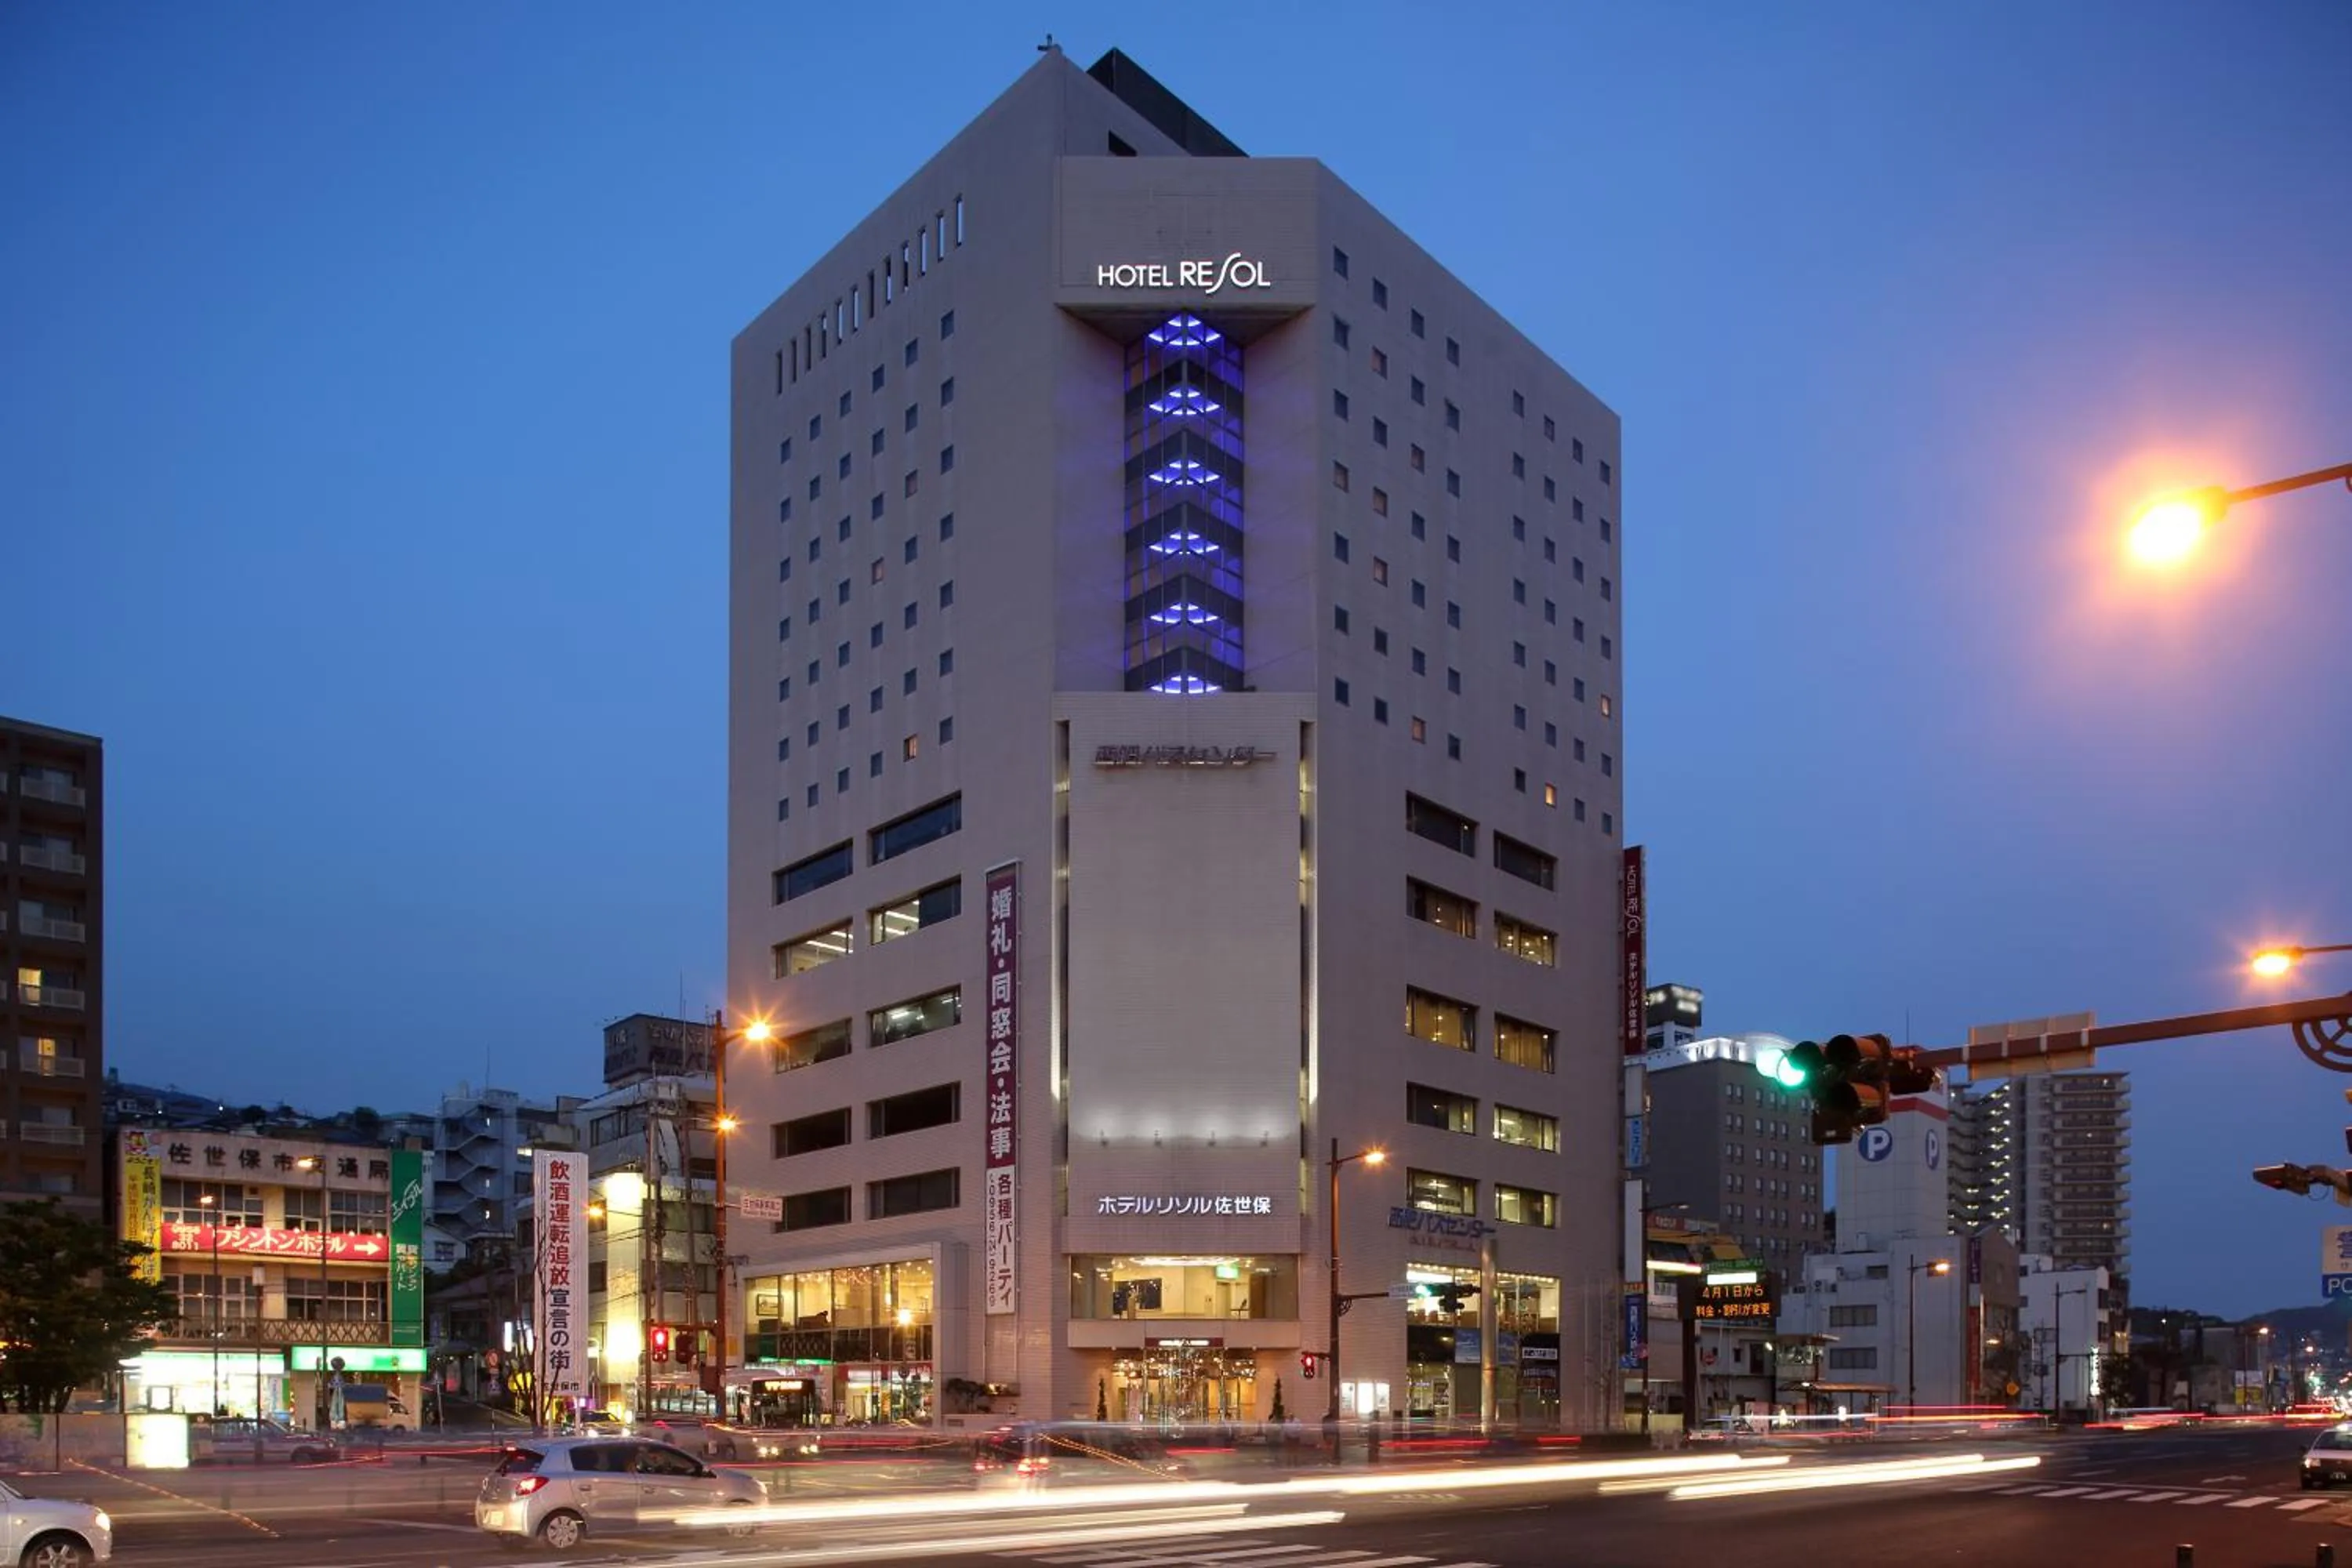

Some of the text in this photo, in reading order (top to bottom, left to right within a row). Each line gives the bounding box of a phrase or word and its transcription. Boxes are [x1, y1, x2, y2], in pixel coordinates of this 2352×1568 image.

[1098, 252, 1272, 295] HOTEL RESOL
[1625, 865, 1642, 938] HOTEL RESOL
[990, 887, 1011, 1160] 婚礼・同窓会・法事
[1867, 1129, 1890, 1160] P
[1928, 1131, 1939, 1167] P
[1098, 1196, 1272, 1214] ホテルリソル佐世保
[212, 1228, 347, 1254] ワシントンホテル
[998, 1173, 1014, 1308] 各種パーティ
[550, 1160, 570, 1370] 飲酒運転追放宣言の街
[1702, 1285, 1763, 1298] 4月1日から
